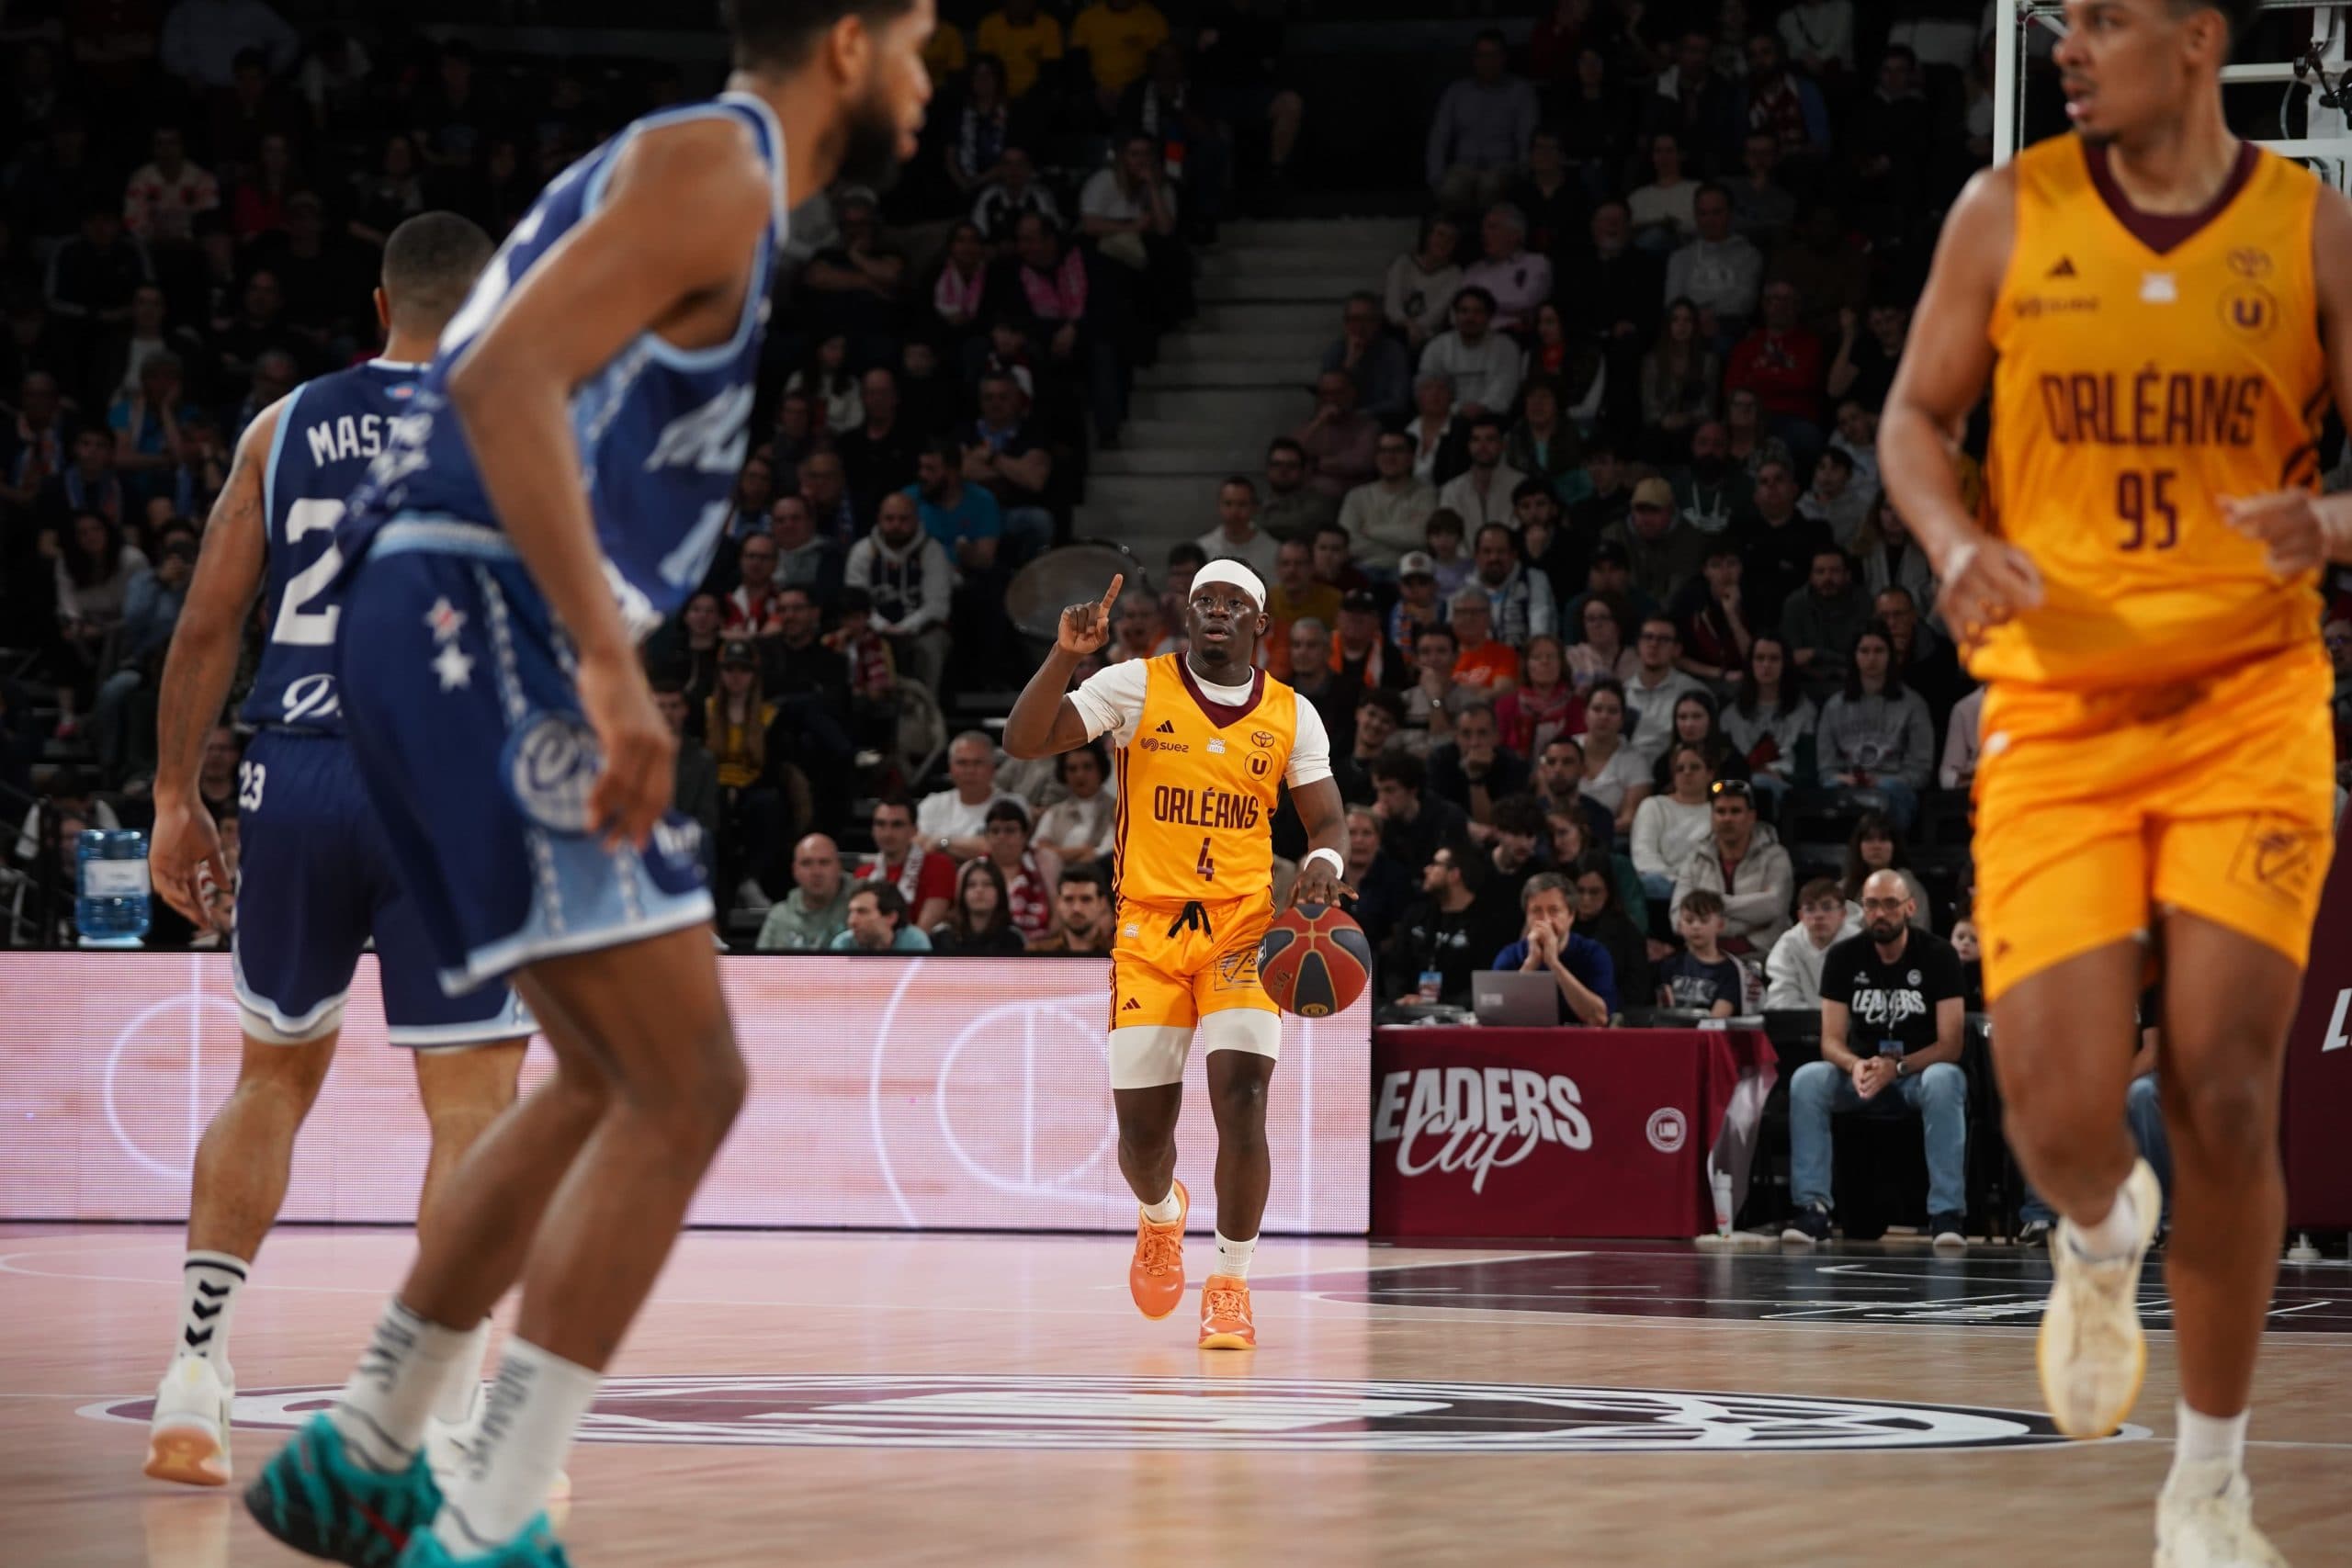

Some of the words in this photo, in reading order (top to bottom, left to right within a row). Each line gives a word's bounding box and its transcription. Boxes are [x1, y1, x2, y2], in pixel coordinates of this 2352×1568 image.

[2040, 361, 2266, 447] ORLÉANS
[2117, 470, 2177, 551] 95
[239, 760, 266, 812] 23
[1153, 785, 1260, 830] ORLÉANS
[1195, 837, 1216, 882] 4
[1396, 1105, 1540, 1195] Cup
